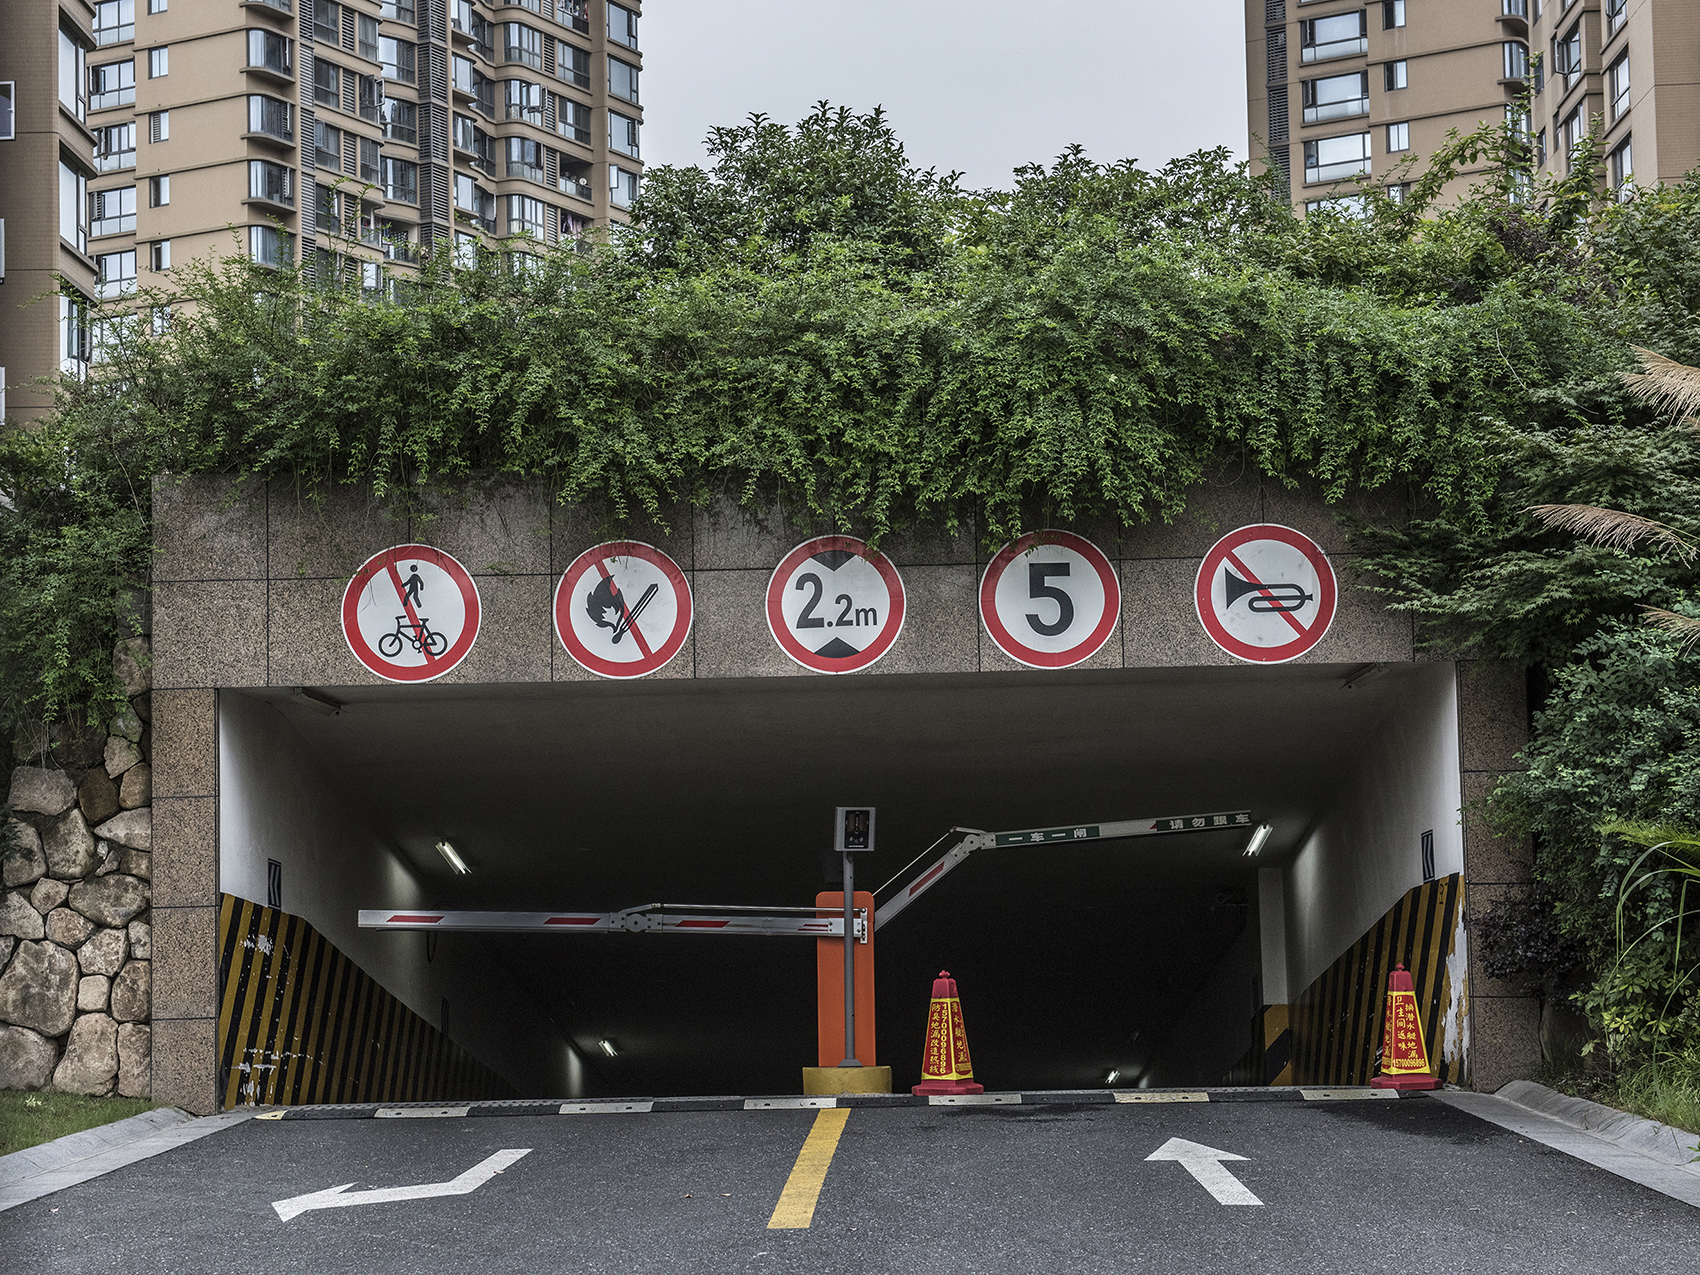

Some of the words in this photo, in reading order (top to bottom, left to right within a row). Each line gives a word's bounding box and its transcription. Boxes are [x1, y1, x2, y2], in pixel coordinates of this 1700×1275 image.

[795, 572, 878, 629] 2.2m
[1025, 562, 1074, 637] 5
[1008, 828, 1087, 842] 一车一闸
[1169, 813, 1250, 830] 请勿跟车
